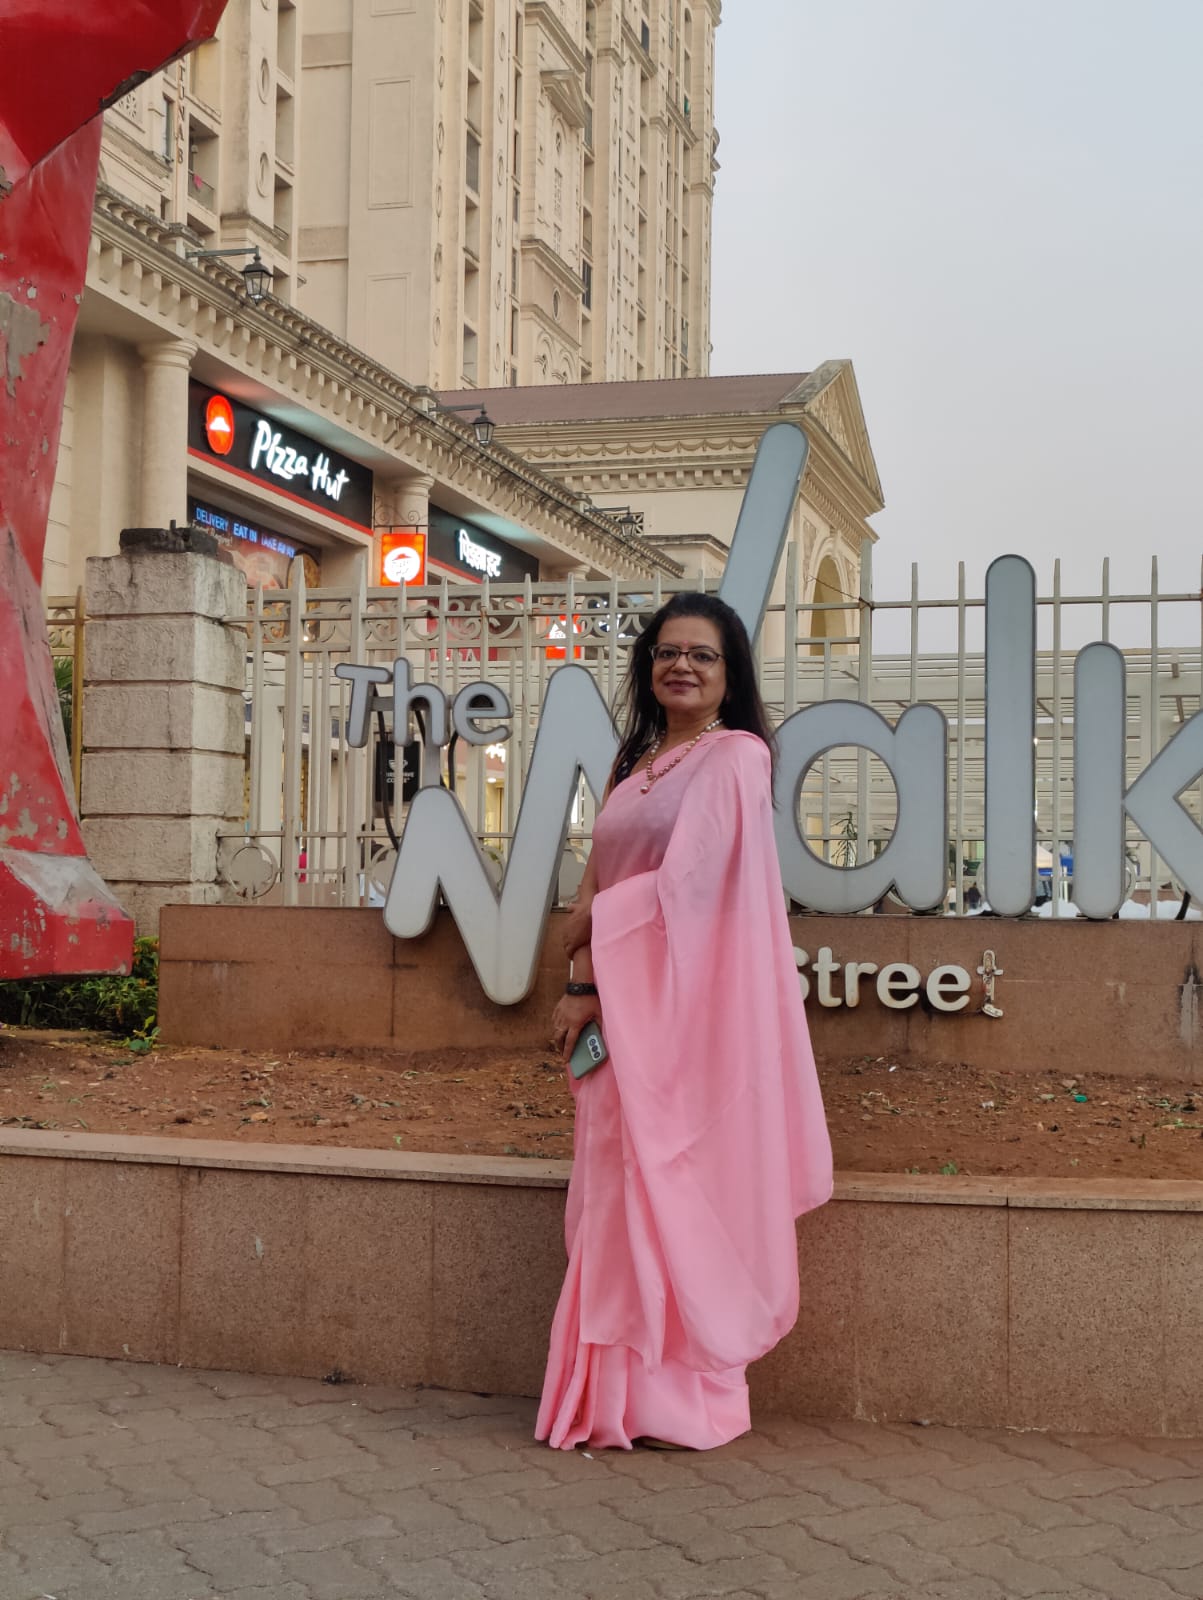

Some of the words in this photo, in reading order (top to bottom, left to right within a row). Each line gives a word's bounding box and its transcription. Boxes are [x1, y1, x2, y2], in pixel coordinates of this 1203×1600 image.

[251, 420, 309, 480] Pizza
[312, 453, 350, 502] Hut
[196, 507, 229, 531] DELIVERY
[233, 522, 248, 540] EAT
[249, 528, 258, 543] IN
[334, 657, 514, 748] The
